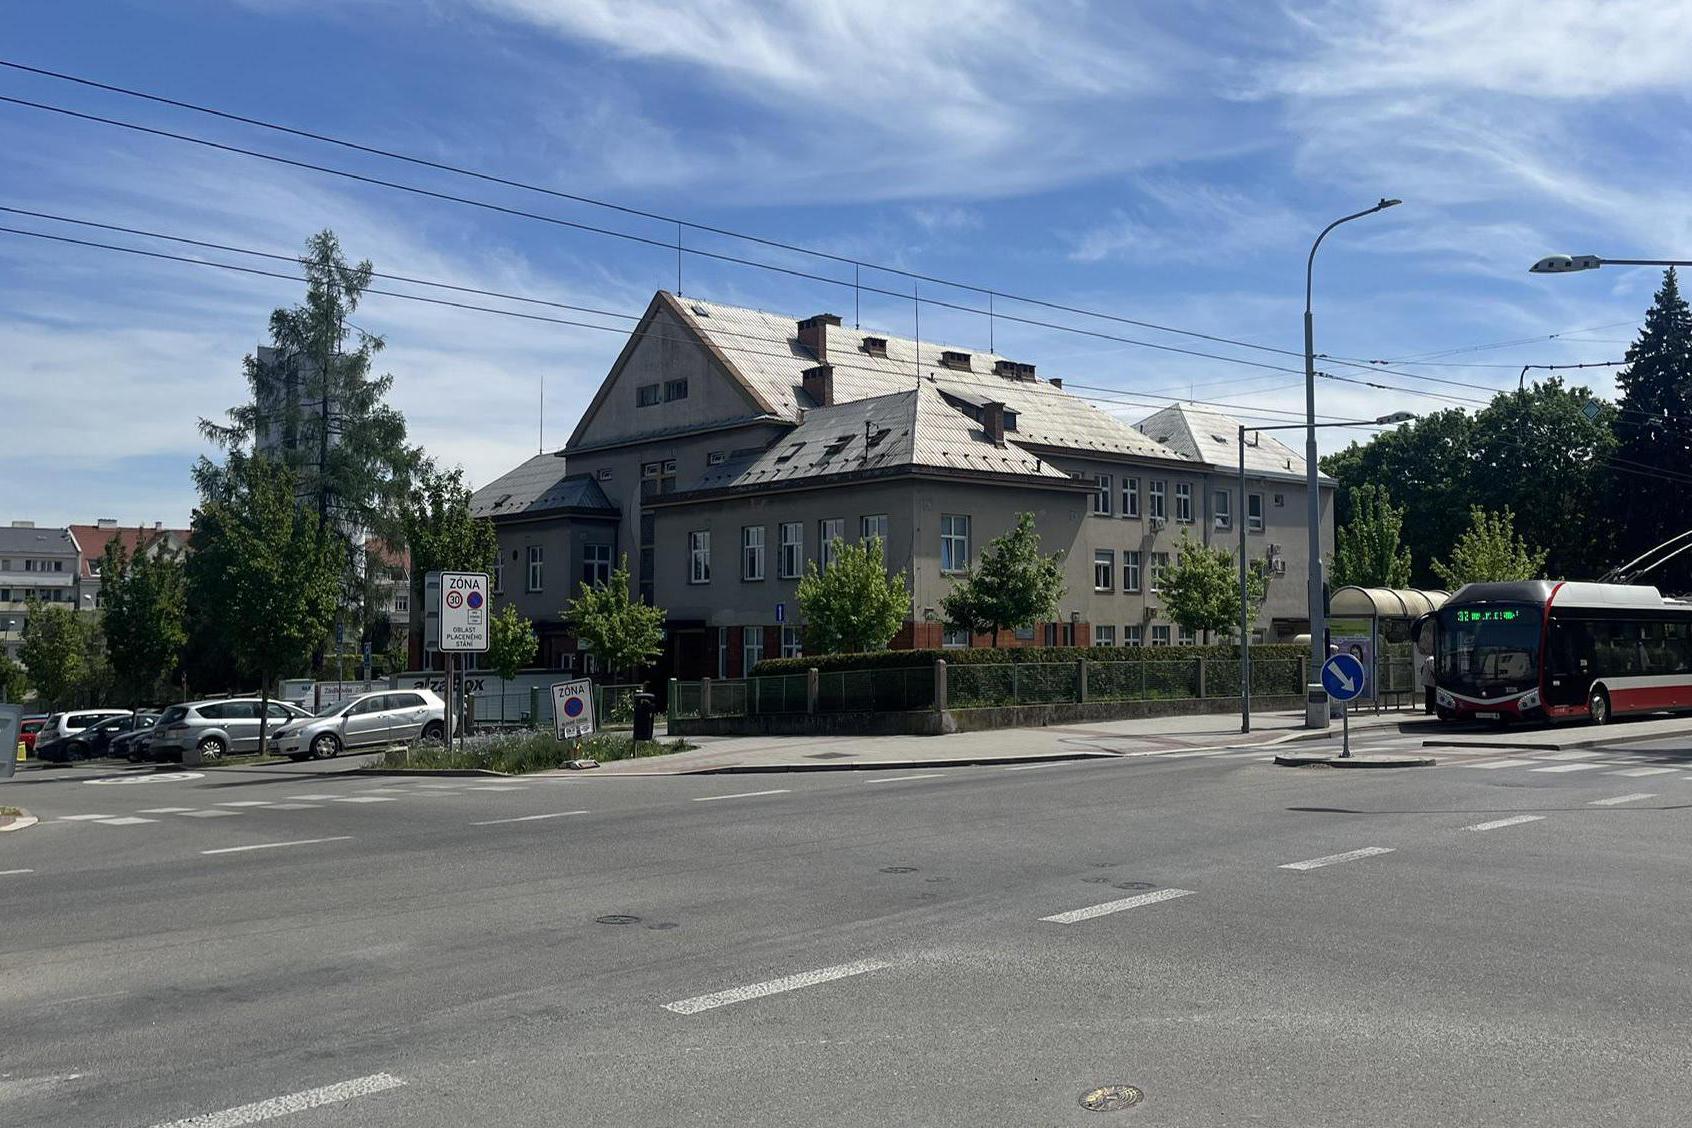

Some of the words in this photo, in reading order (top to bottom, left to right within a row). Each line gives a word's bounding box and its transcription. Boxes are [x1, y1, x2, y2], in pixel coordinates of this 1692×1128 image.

[449, 576, 480, 590] ZÓNA
[450, 595, 460, 605] 30
[446, 633, 483, 641] PLACENÉHO
[558, 684, 585, 698] ZÓNA
